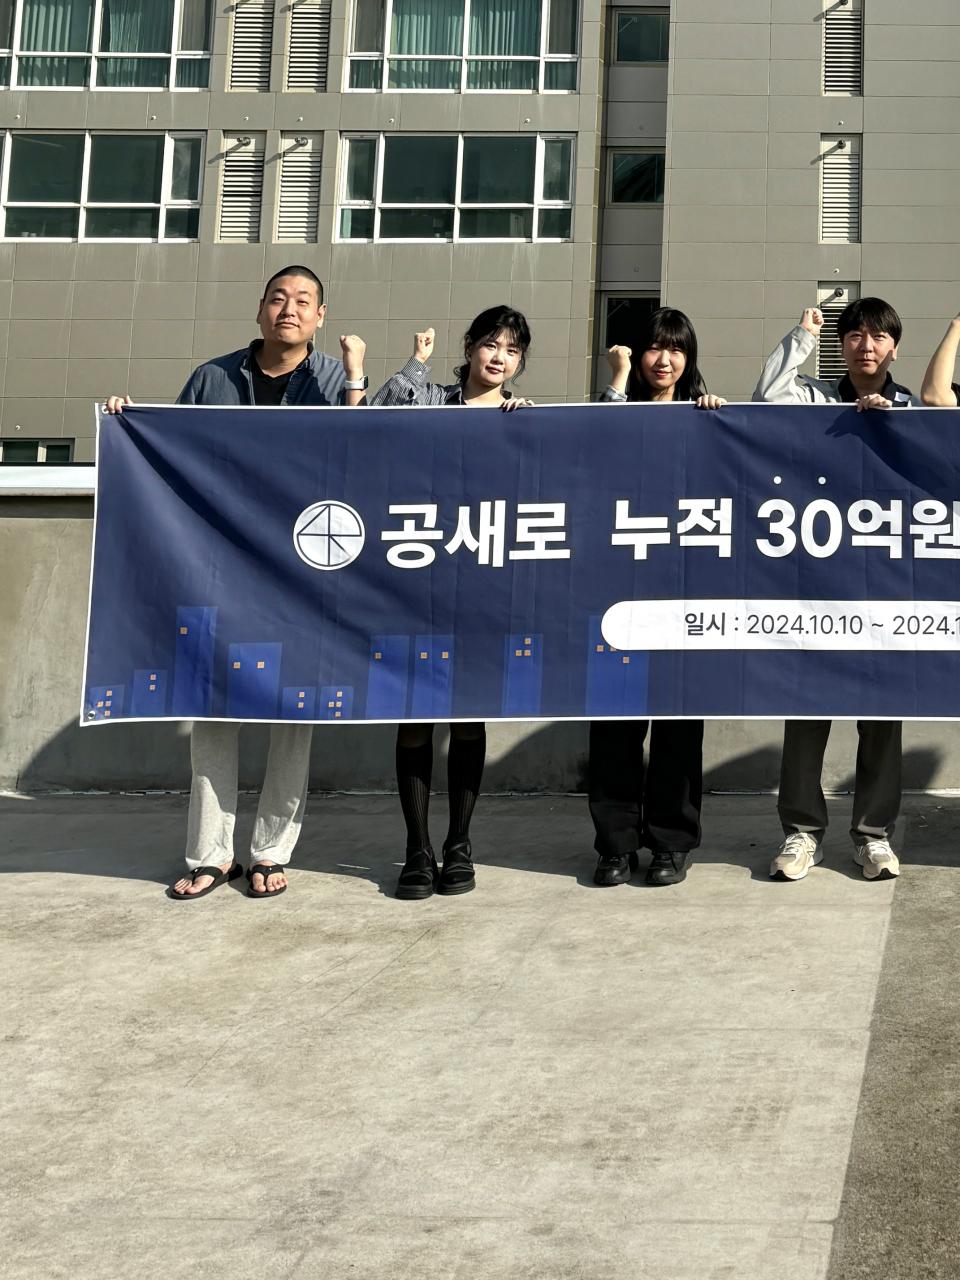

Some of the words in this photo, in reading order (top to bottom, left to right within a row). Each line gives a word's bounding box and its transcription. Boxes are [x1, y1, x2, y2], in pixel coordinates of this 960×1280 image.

[380, 499, 571, 569] 공새로
[611, 497, 733, 561] 누적
[684, 612, 726, 636] 일시
[746, 614, 863, 635] 2024.10.10
